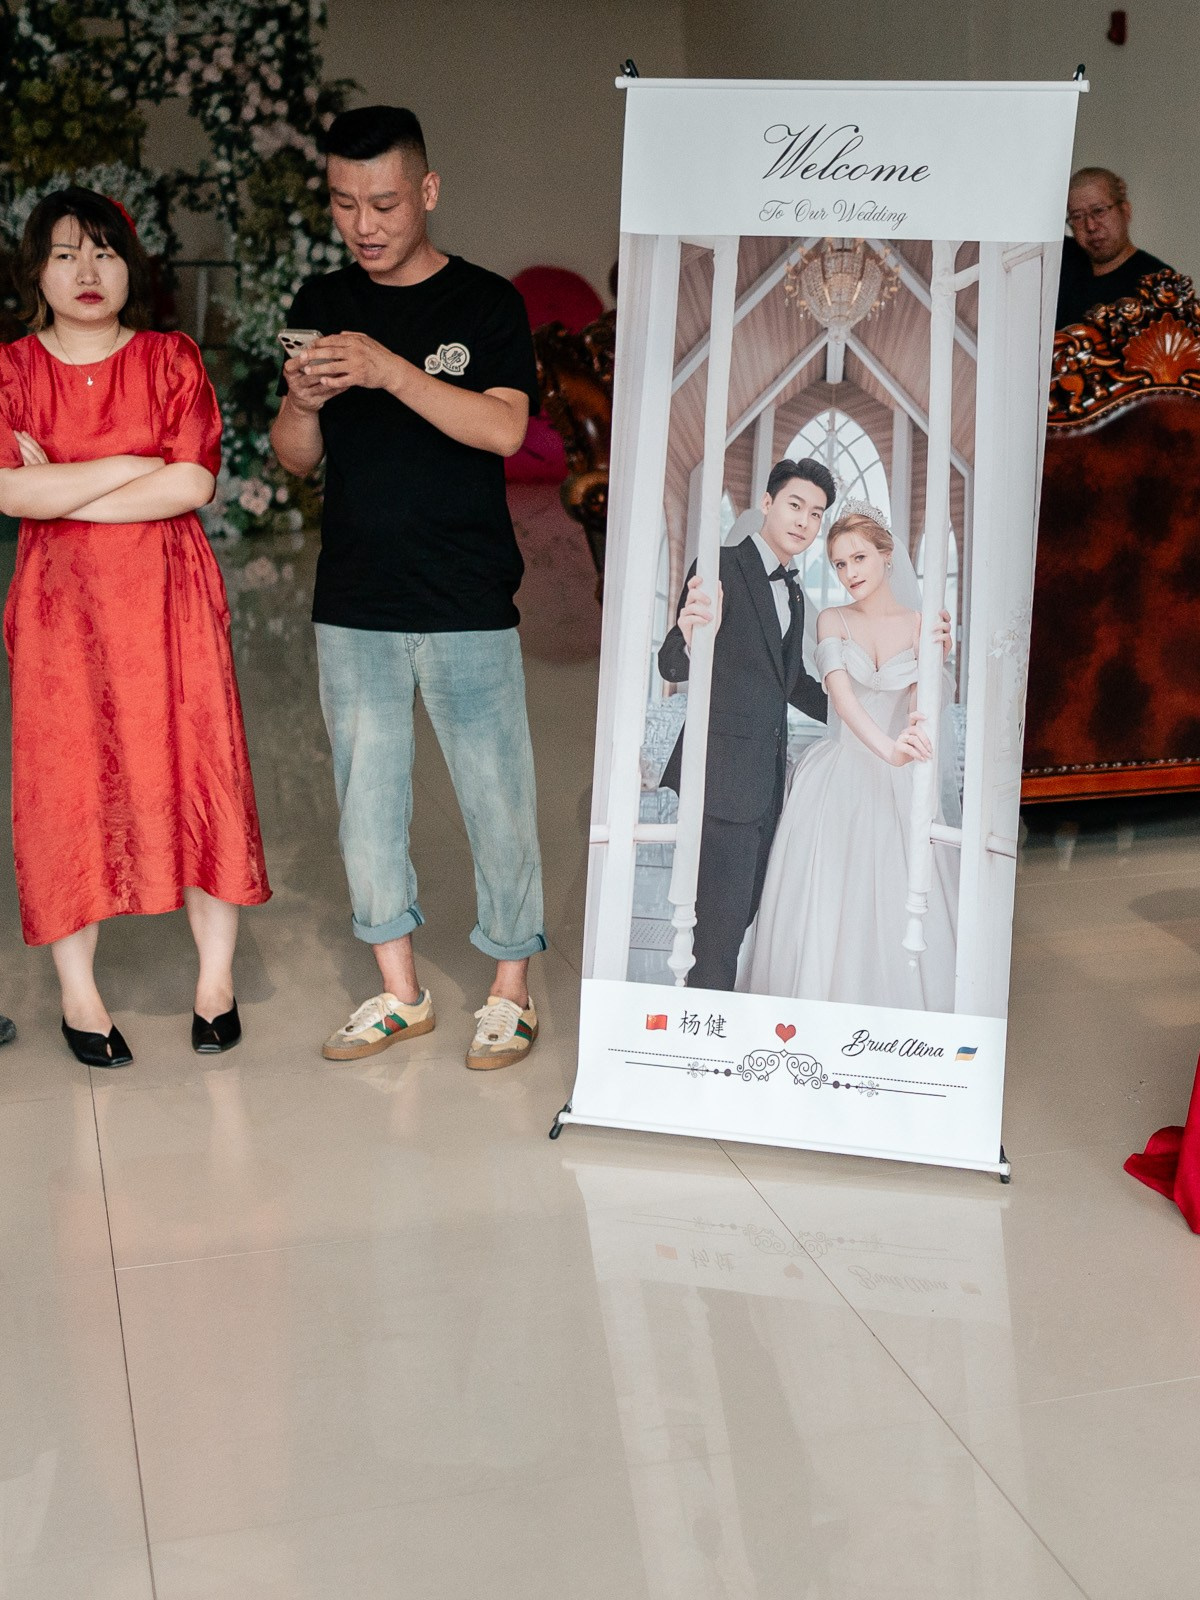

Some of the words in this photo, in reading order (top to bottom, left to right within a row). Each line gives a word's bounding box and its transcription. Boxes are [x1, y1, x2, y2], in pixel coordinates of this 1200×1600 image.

[762, 123, 931, 183] Welcome
[758, 199, 794, 222] To
[794, 198, 829, 223] Our
[832, 198, 908, 231] Wedding
[678, 1009, 727, 1039] 杨健
[898, 1037, 945, 1058] Alina
